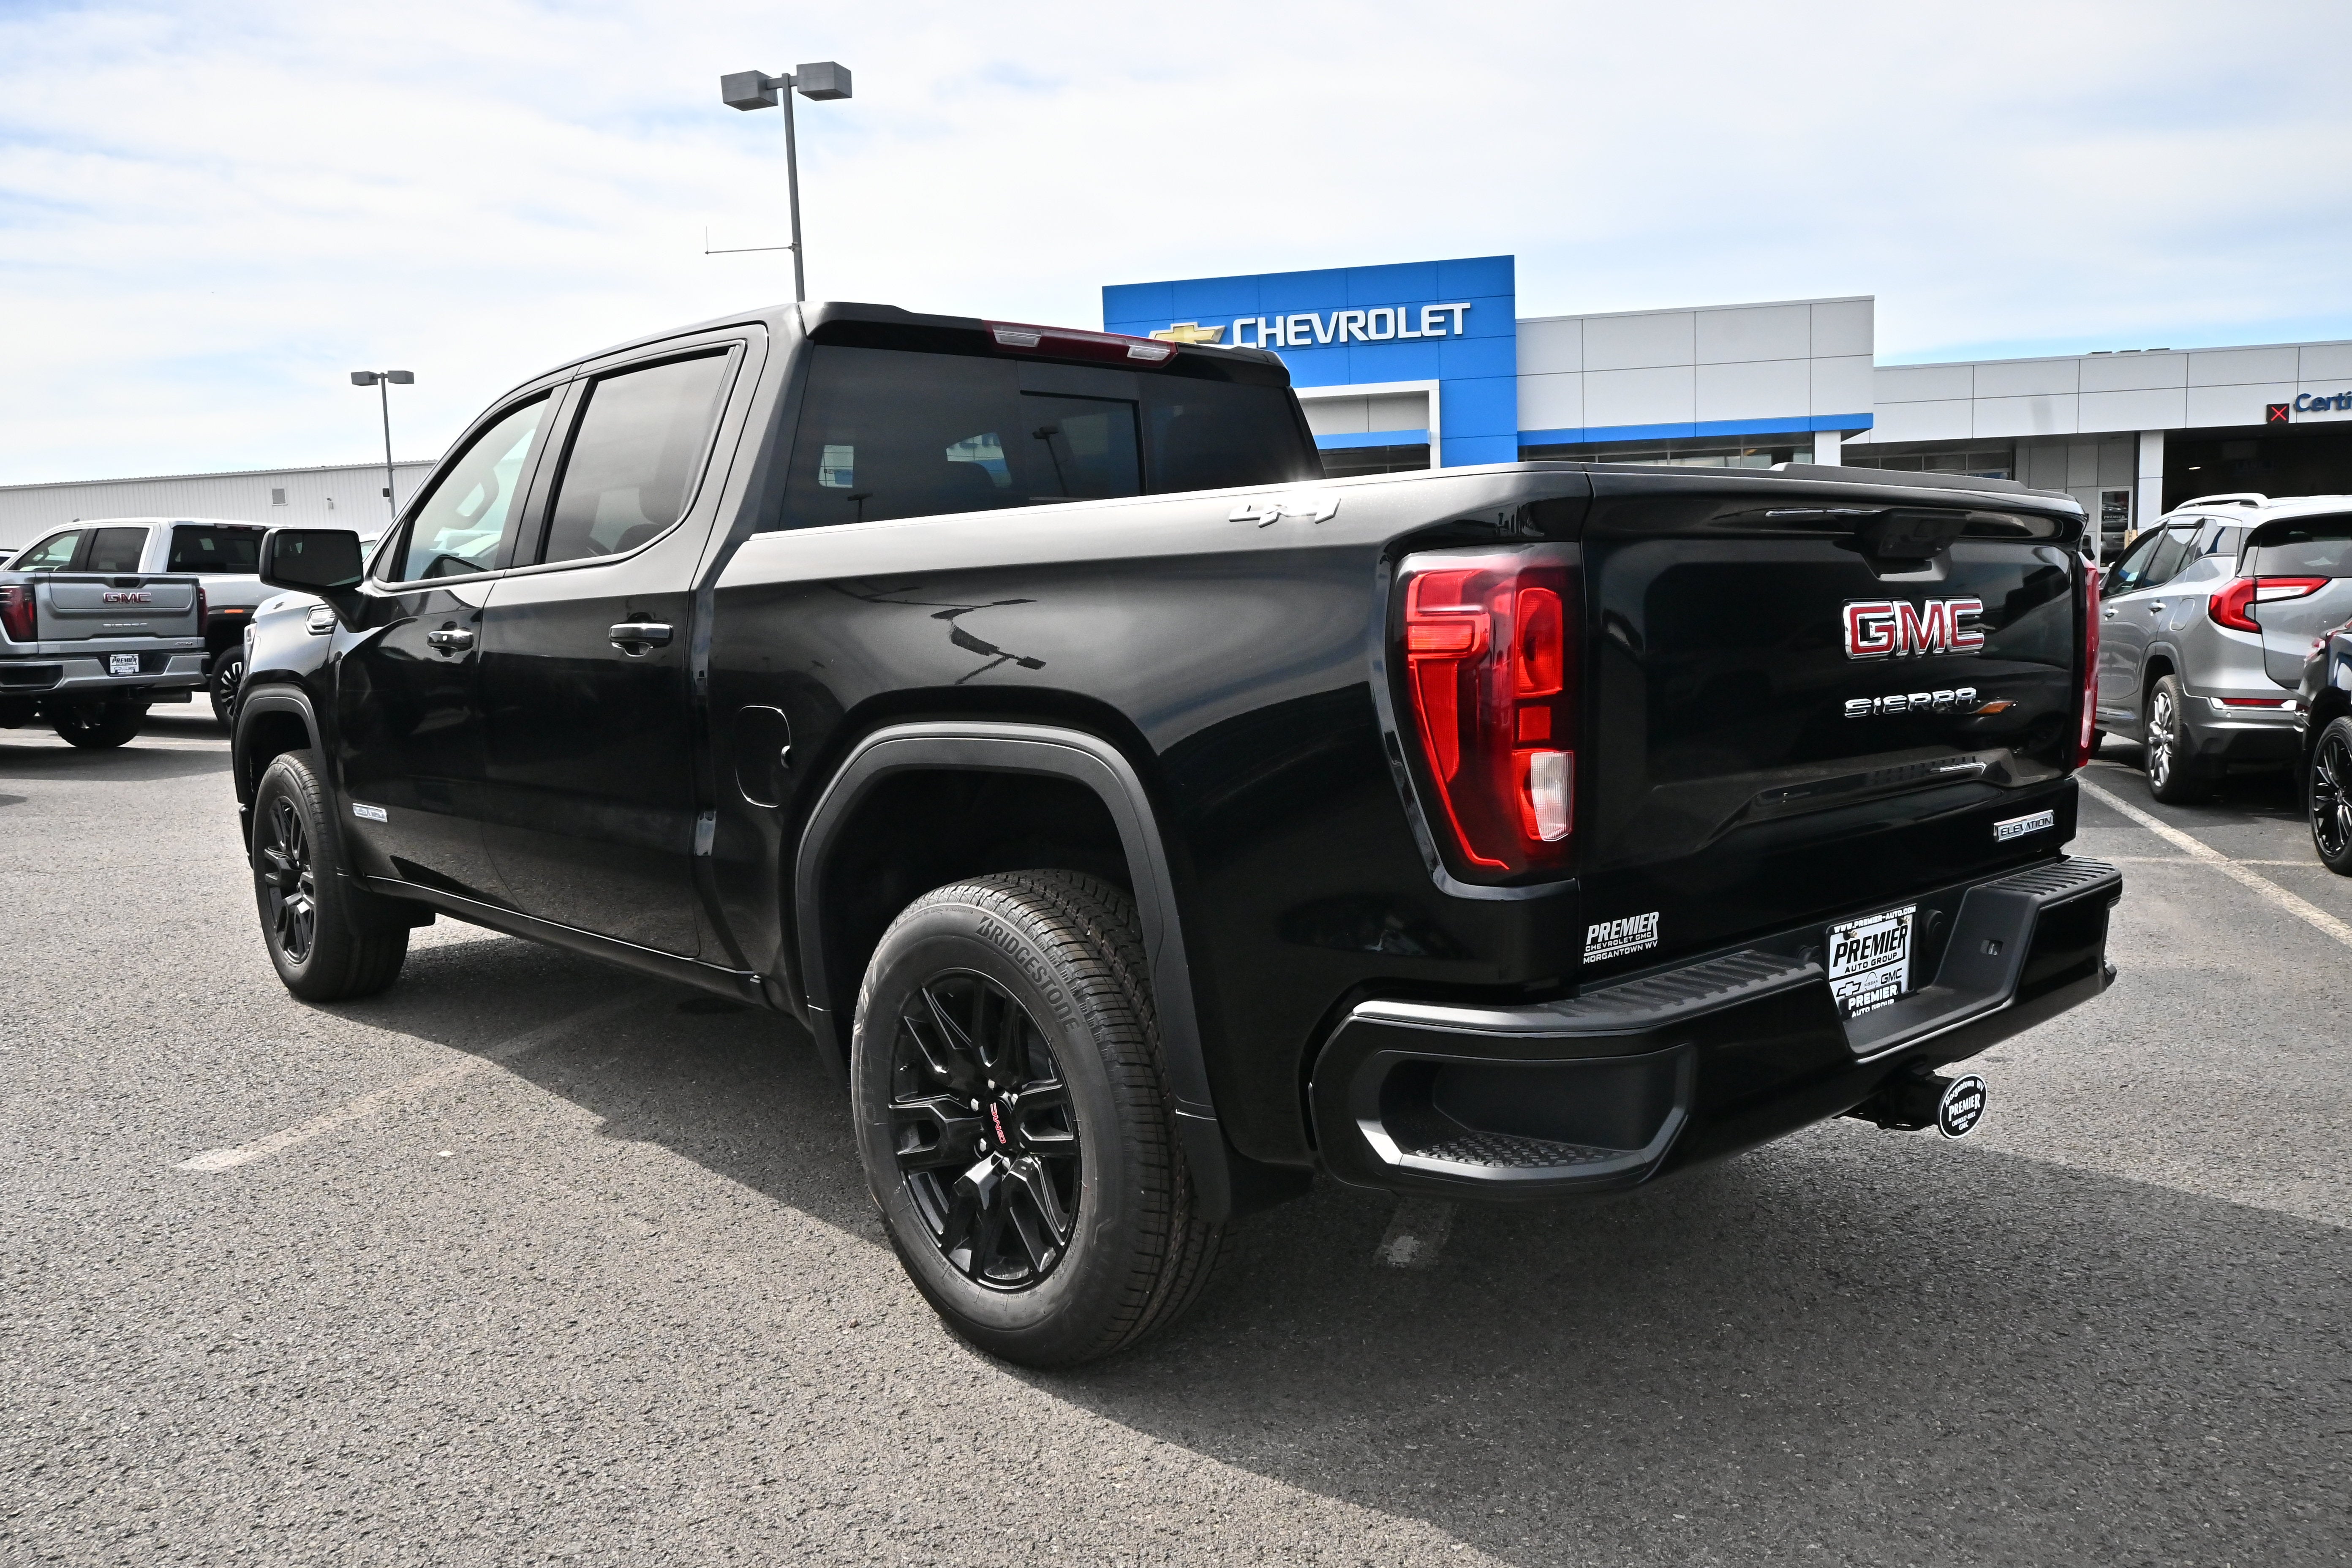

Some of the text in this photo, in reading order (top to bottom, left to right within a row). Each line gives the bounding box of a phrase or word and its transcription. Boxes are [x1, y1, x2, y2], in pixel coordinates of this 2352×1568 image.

[1232, 302, 1471, 349] CHEVROLET
[103, 592, 152, 604] GMC
[1843, 598, 1984, 660] GMC
[1843, 687, 1977, 718] SIERRA
[2001, 817, 2052, 836] ELEVATION
[1586, 911, 1659, 945] PREMIER
[1834, 906, 1916, 934] WWW.PREMIER-AUTO.COM
[1583, 940, 1658, 964] MORGANTOWN WV
[1585, 931, 1652, 952] CHEVROLET GMC
[1832, 924, 1908, 968] PREMIER
[975, 916, 1080, 1034] BRIDGESTONE
[1844, 952, 1897, 974] AUTO GROUP
[1881, 967, 1903, 985] GMC
[1848, 984, 1897, 1010] PREMIER
[1851, 1006, 1870, 1018] AUTO
[1945, 1079, 1984, 1108] Morgantown WV
[1948, 1093, 1981, 1122] PREMIER
[990, 1102, 1007, 1144] GMC
[1958, 1120, 1969, 1130] GMC
